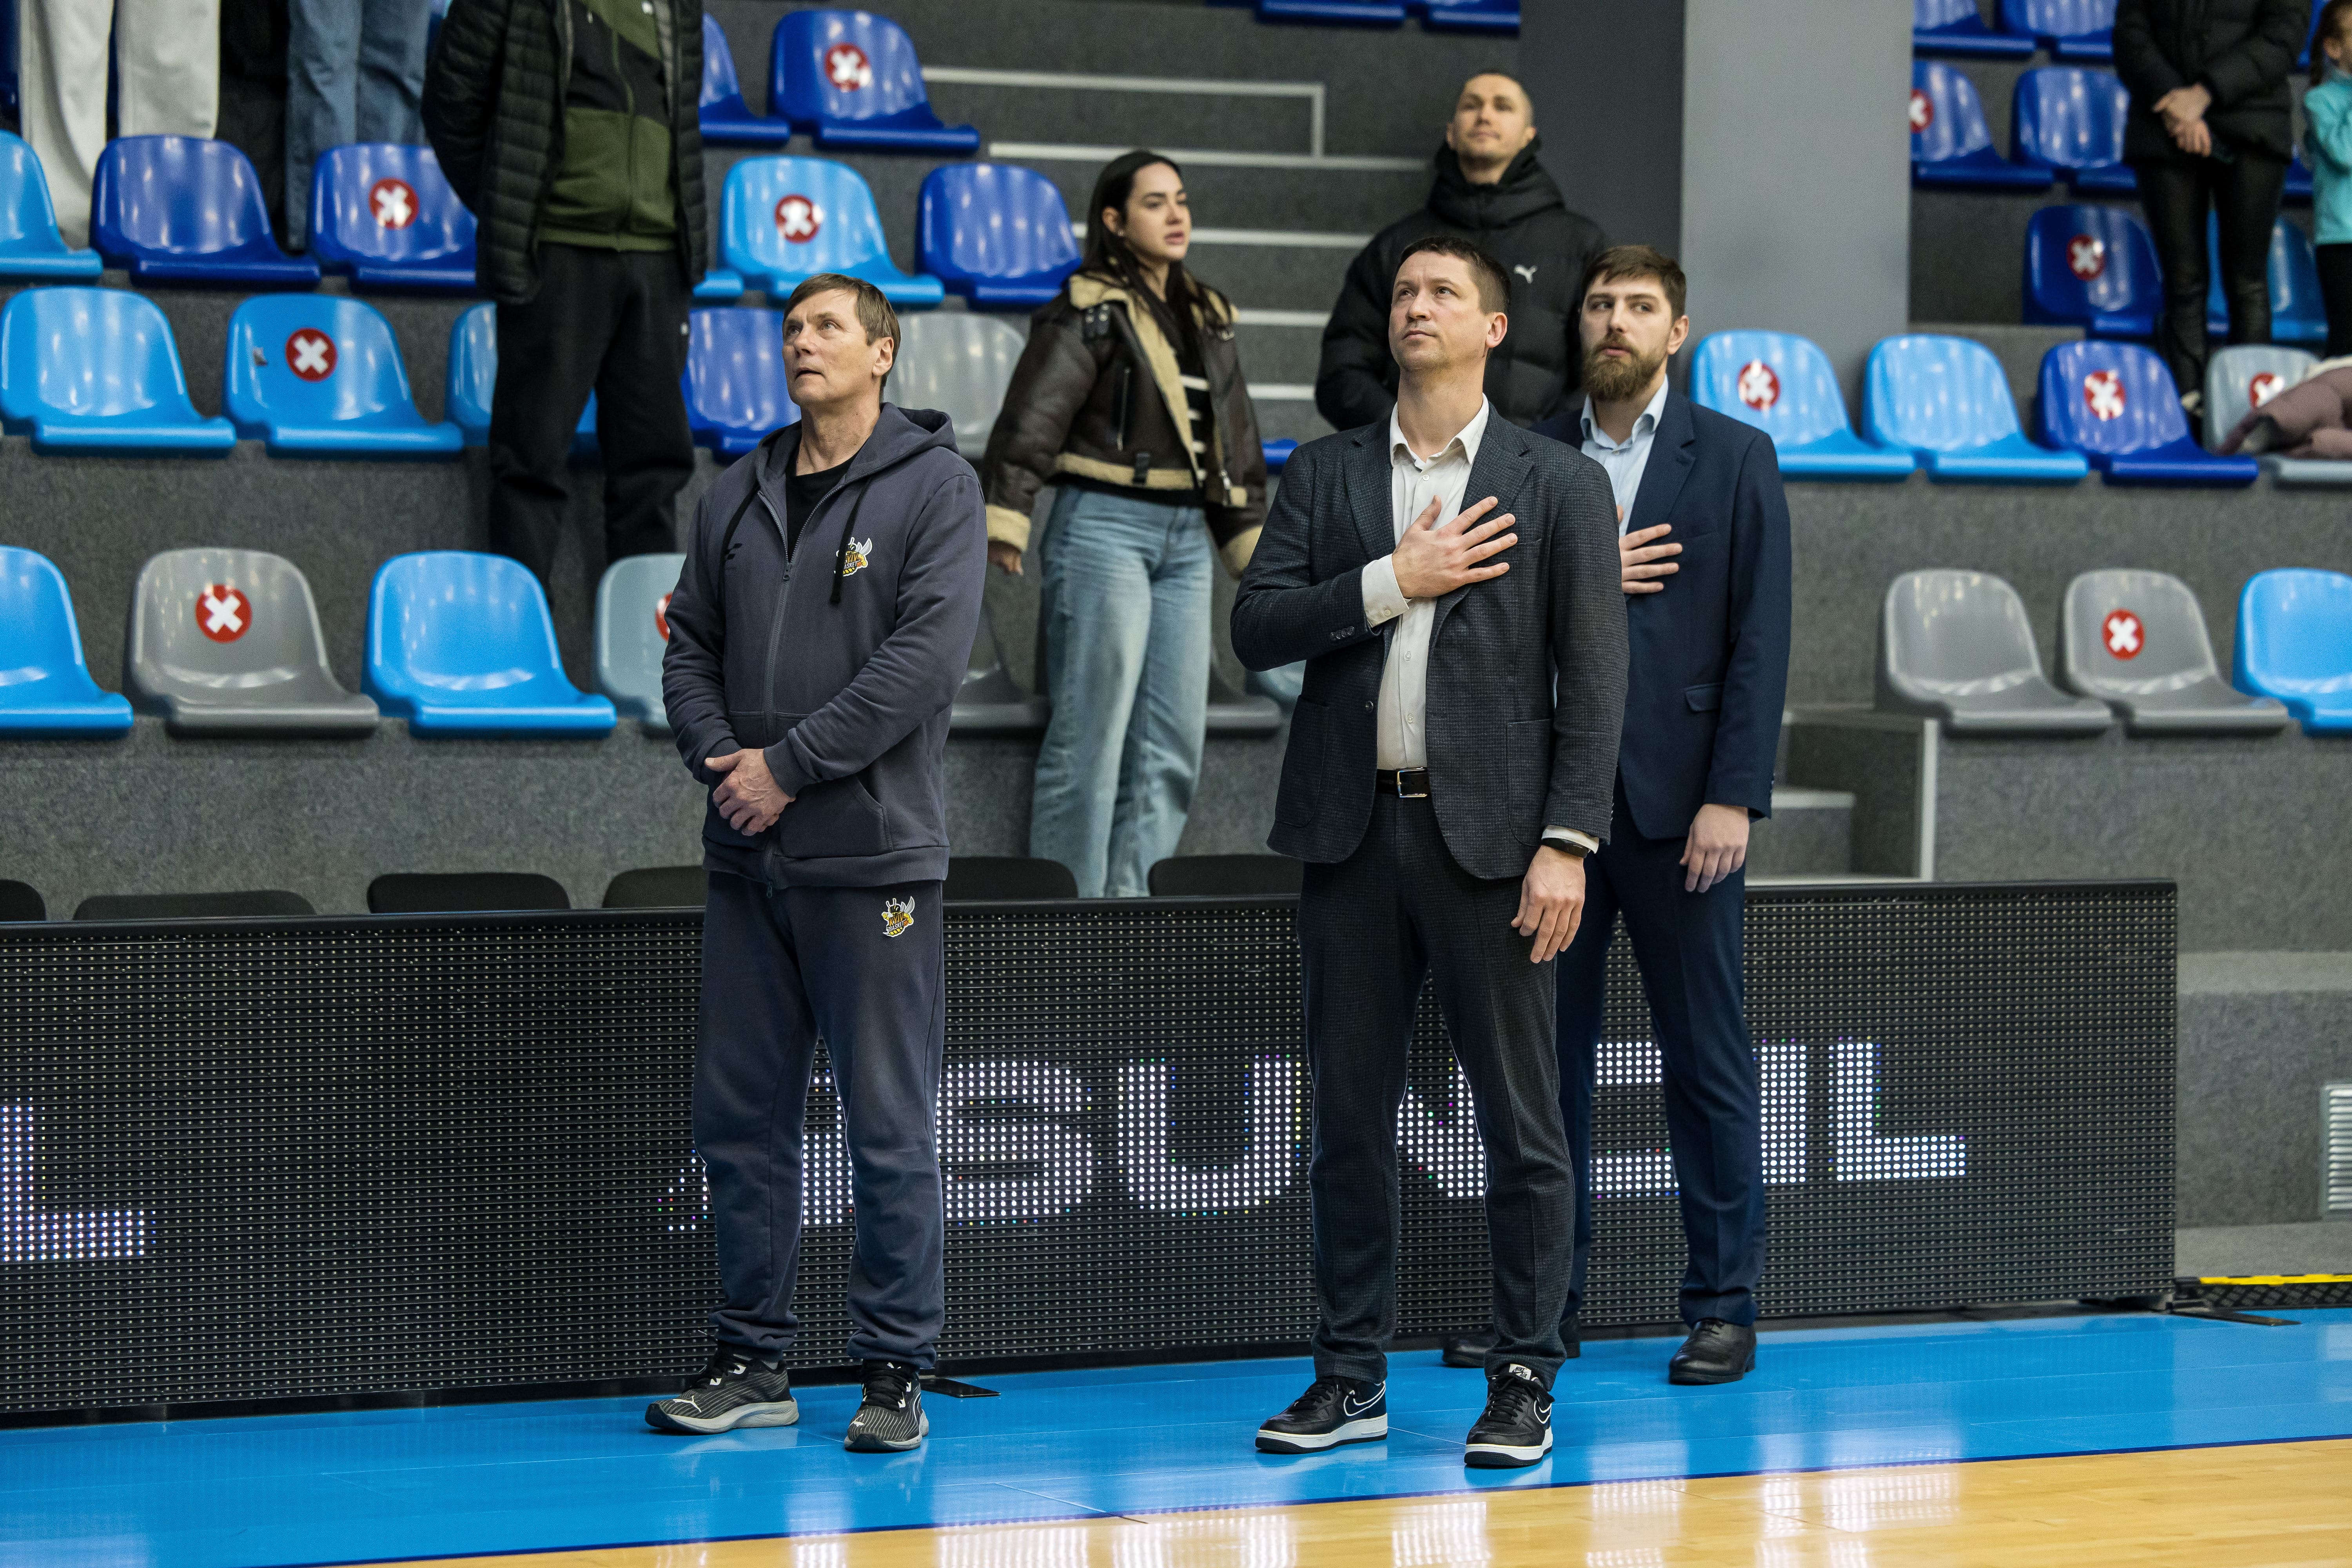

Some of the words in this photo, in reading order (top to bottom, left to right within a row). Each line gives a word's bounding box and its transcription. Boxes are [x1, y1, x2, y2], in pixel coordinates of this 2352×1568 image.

[844, 561, 857, 569] ASKET
[889, 912, 904, 926] KYIV
[889, 921, 904, 931] BASKET
